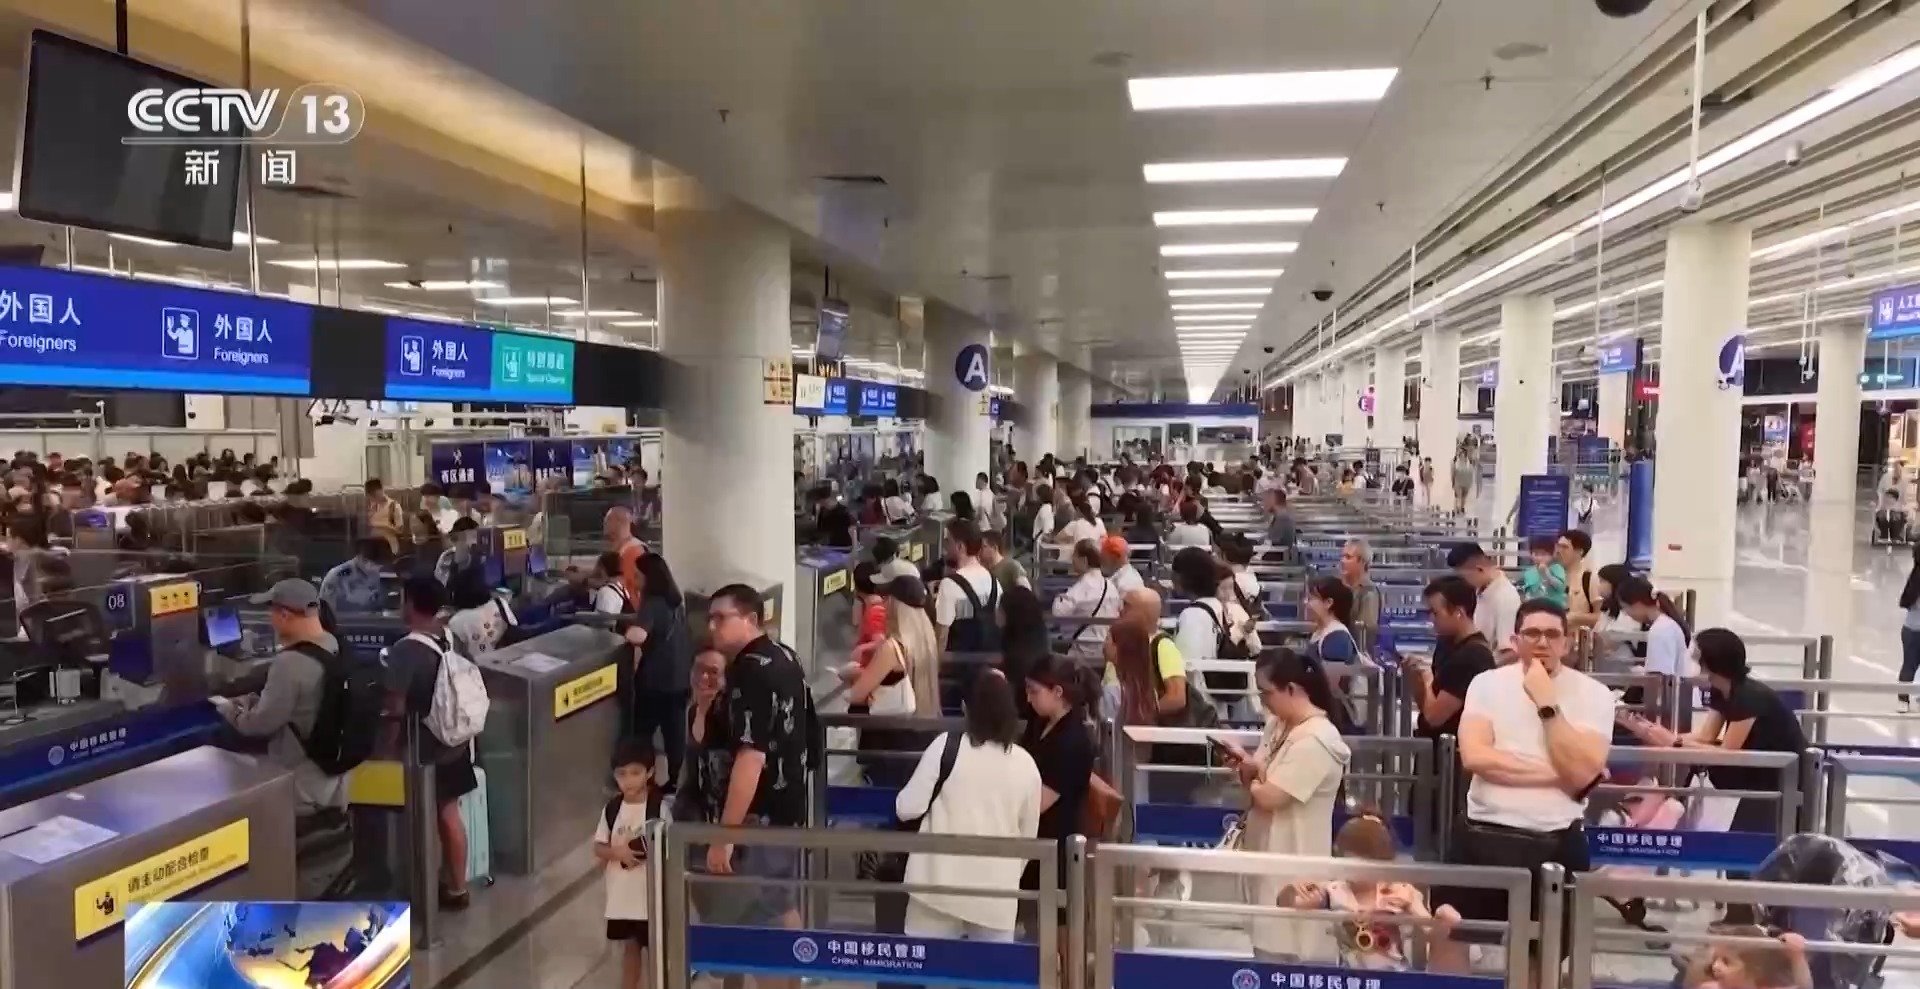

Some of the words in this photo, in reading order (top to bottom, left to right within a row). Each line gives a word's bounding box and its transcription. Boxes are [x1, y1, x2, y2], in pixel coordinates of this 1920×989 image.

[0, 289, 81, 325] 外国人
[214, 313, 273, 343] 外国人
[0, 329, 77, 353] Foreigners
[432, 339, 468, 362] 外国人
[214, 347, 269, 365] Foreigners
[964, 352, 987, 383] A
[108, 593, 125, 610] 08
[1597, 833, 1682, 847] 中国移民管理
[827, 939, 926, 960] 中国移民管理
[832, 956, 858, 965] CHINA
[863, 958, 923, 969] IMMIGRATION
